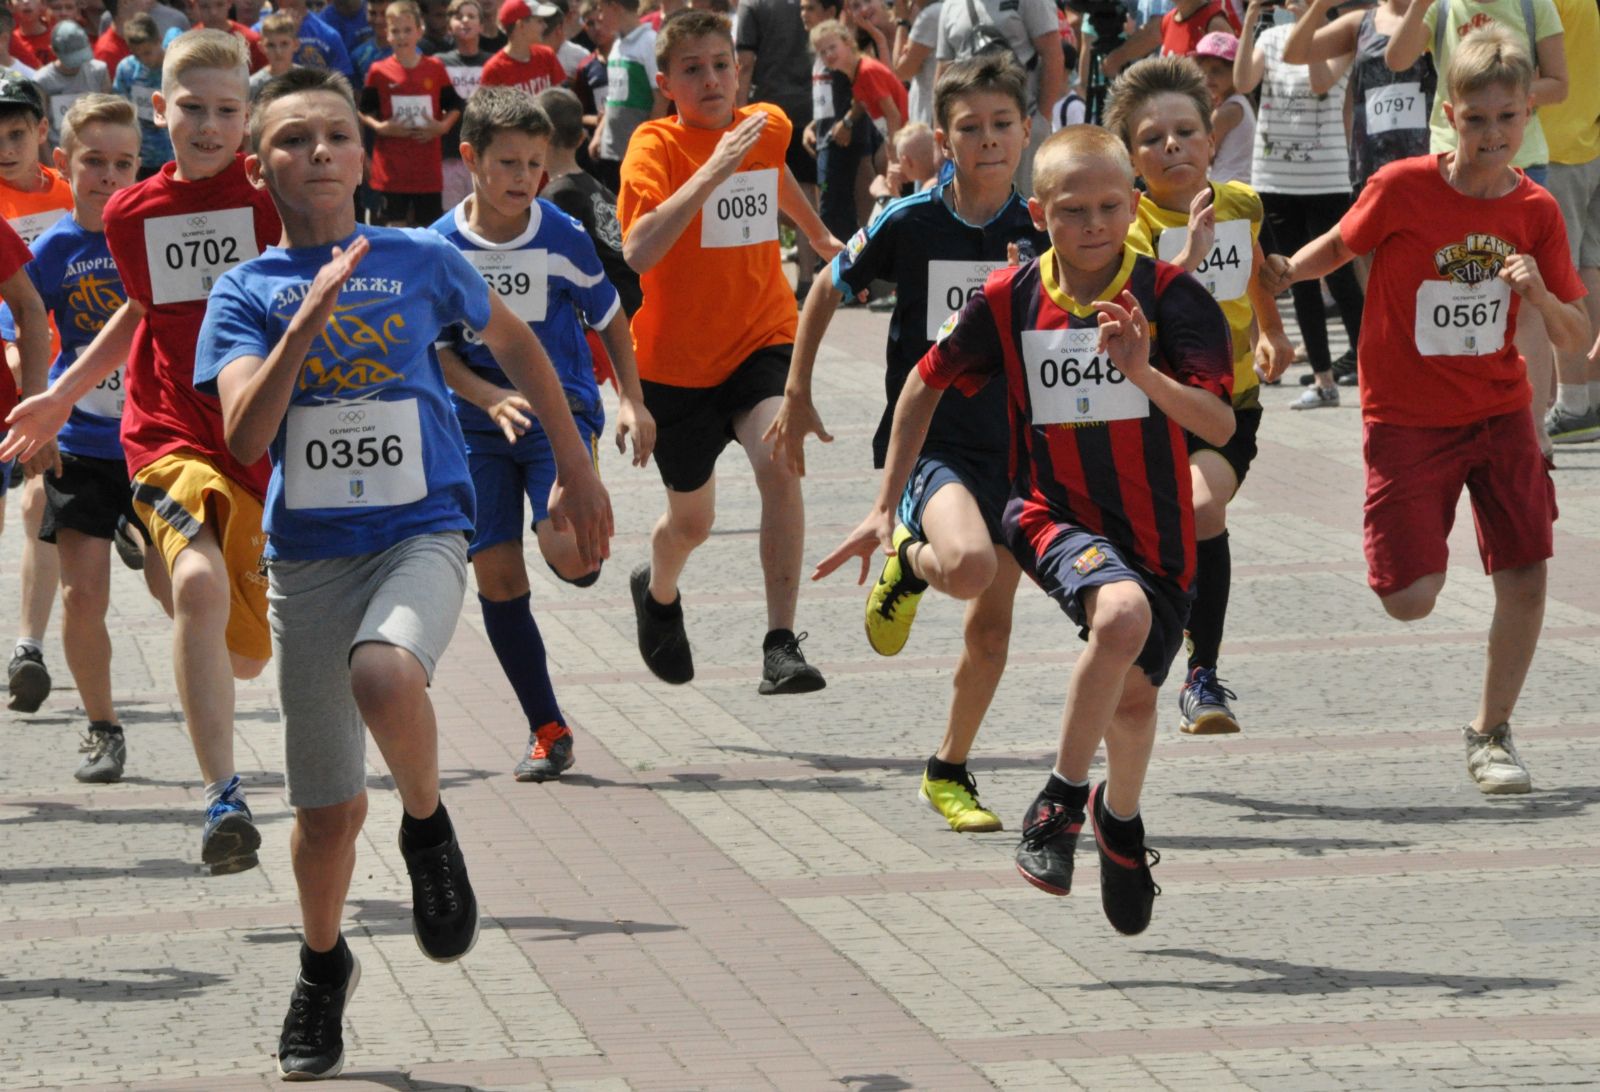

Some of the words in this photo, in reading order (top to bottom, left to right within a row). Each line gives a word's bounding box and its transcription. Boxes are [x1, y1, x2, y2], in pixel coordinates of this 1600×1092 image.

[1374, 96, 1415, 115] 0797
[717, 193, 768, 220] 0083
[166, 237, 240, 270] 0702
[1196, 245, 1240, 274] 44
[483, 272, 530, 295] 39
[1433, 299, 1501, 328] 0567
[1040, 356, 1126, 388] 0648
[329, 426, 361, 436] OLYMPIC
[306, 434, 403, 470] 0356
